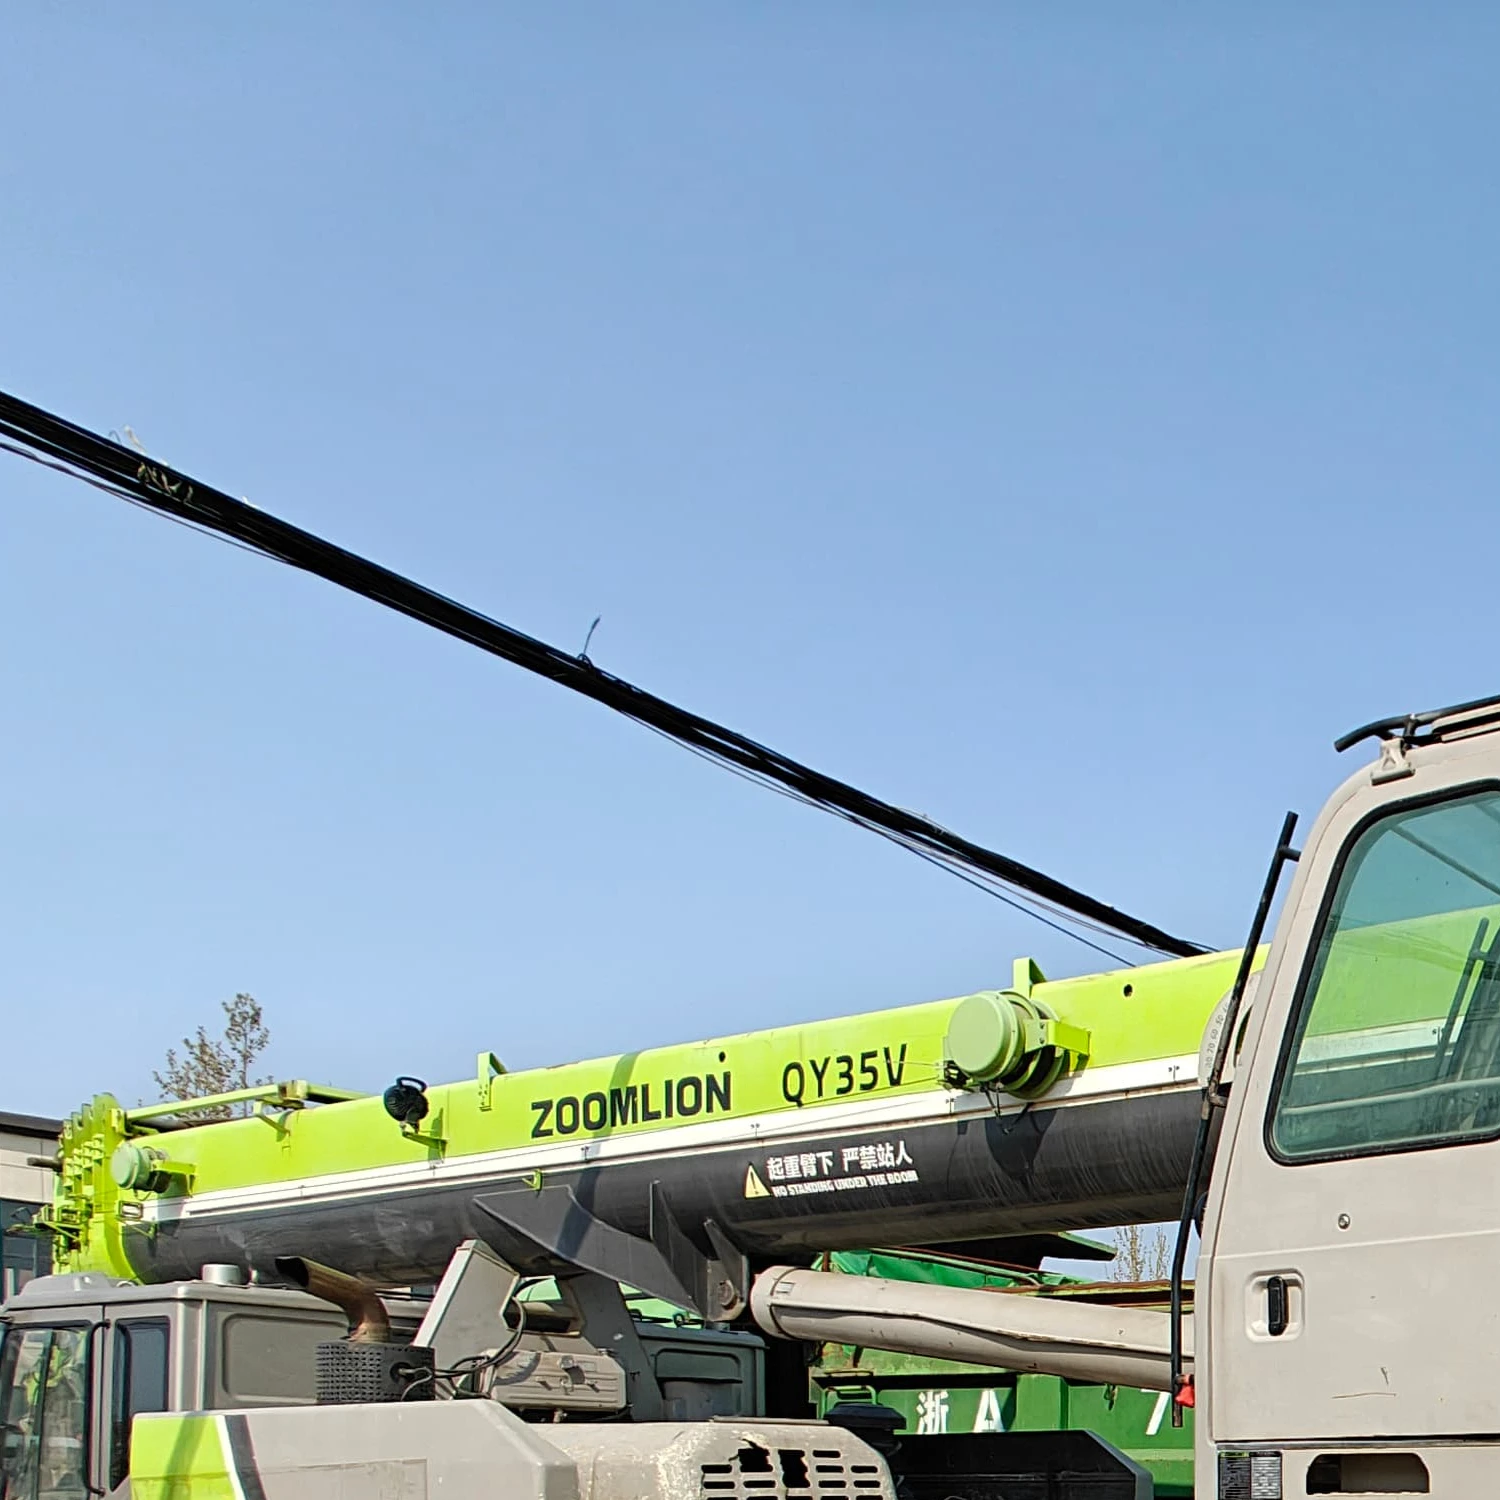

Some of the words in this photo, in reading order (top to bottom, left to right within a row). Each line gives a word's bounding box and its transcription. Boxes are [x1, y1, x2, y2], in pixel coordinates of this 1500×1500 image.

[782, 1043, 907, 1108] QY35V
[531, 1071, 731, 1139] ZOOMLION
[766, 1151, 834, 1181] 起重臂下
[841, 1140, 913, 1173] 严禁站人
[771, 1185, 788, 1198] NO
[788, 1181, 835, 1196] STANDING
[835, 1177, 868, 1191] UNDER
[868, 1174, 887, 1187] THE
[887, 1170, 919, 1184] BOOM
[917, 1389, 949, 1435] 浙
[973, 1388, 1005, 1433] A
[1140, 1388, 1171, 1436] 7
